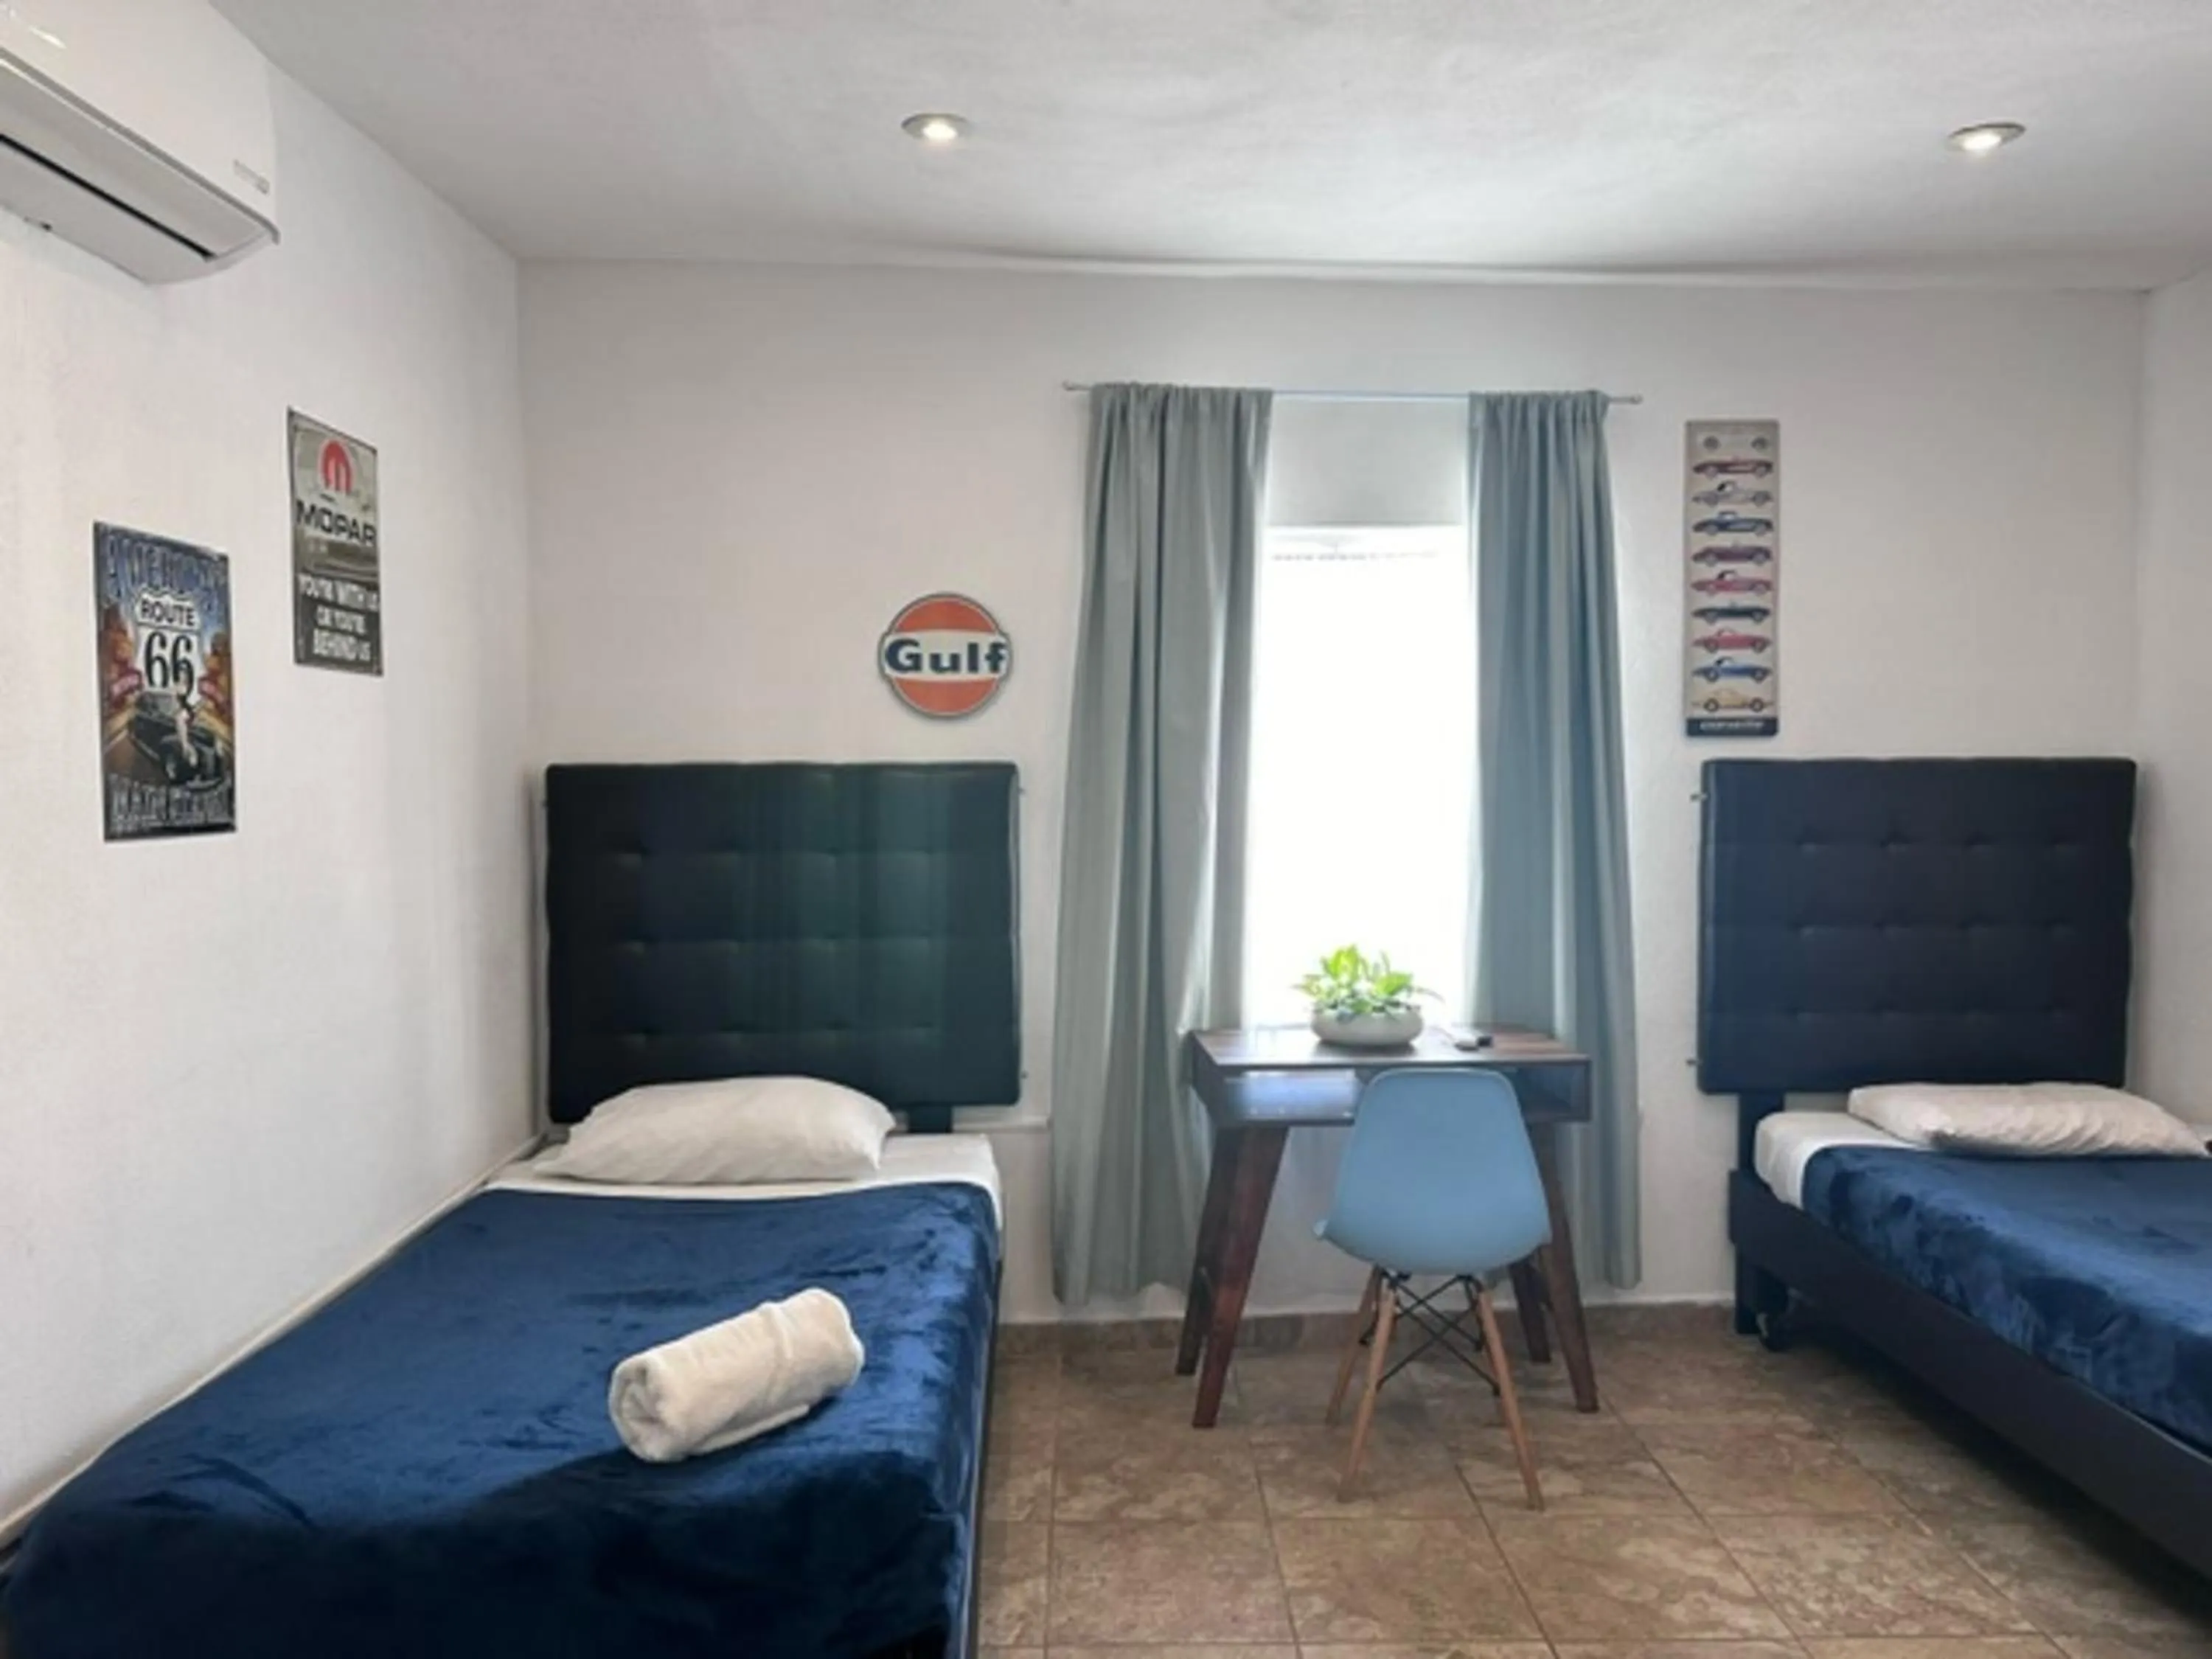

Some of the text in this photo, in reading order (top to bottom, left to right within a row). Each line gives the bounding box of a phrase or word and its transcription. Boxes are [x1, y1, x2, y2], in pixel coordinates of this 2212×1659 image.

[296, 499, 377, 546] MOPAR
[141, 599, 195, 627] ROUTE
[145, 631, 195, 698] 66
[886, 638, 1006, 674] Gulf
